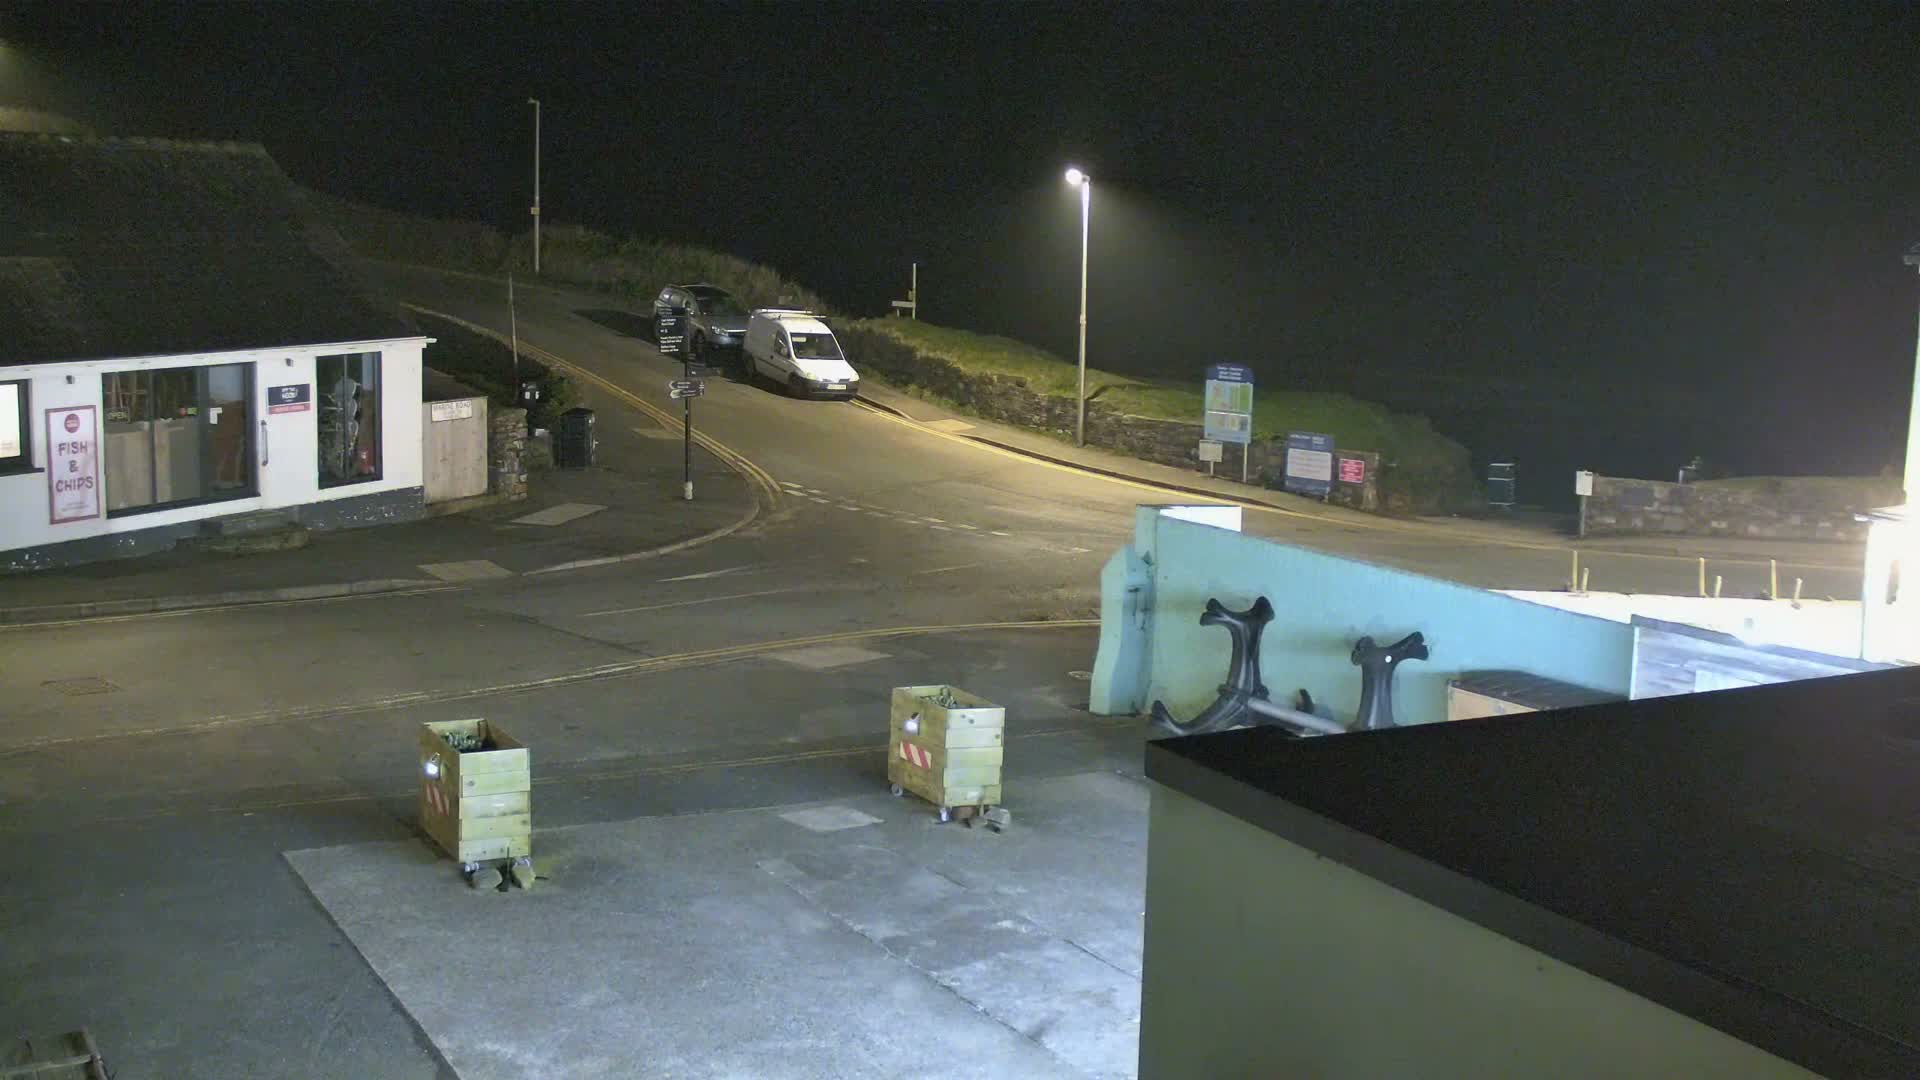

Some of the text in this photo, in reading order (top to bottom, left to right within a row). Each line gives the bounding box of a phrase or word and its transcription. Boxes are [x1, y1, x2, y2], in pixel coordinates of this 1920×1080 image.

[58, 441, 88, 456] FISH
[68, 460, 79, 473] &
[56, 476, 94, 493] CHIPS
